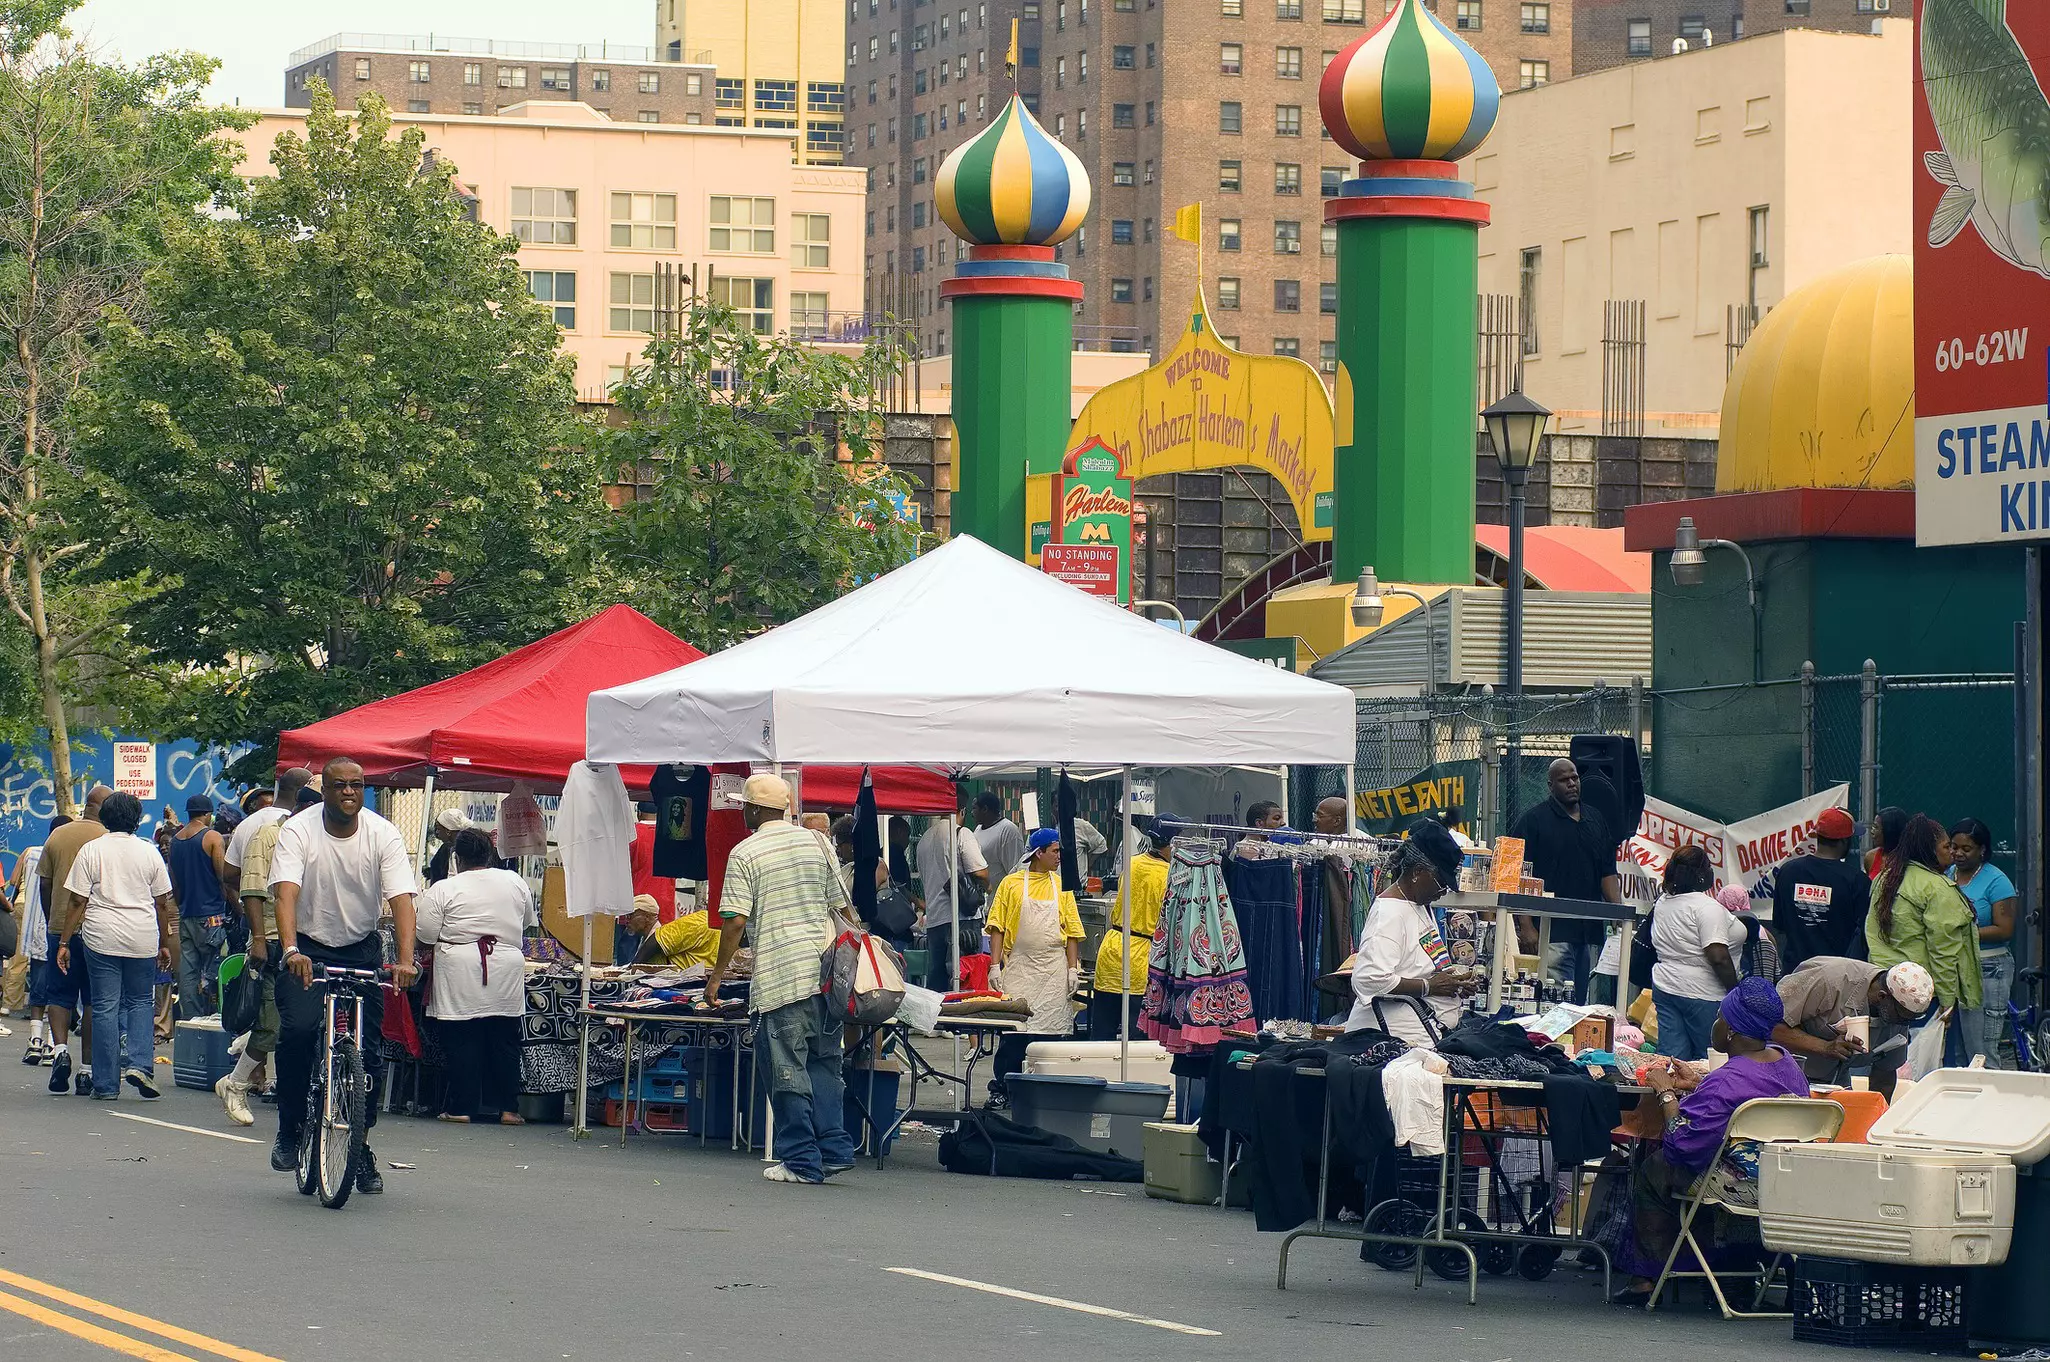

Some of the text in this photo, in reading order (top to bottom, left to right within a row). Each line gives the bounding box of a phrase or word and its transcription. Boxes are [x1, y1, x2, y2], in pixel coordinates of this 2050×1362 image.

[1935, 327, 2028, 372] 60-62W
[1164, 347, 1231, 389] WELCOME
[1190, 377, 1203, 392] TO
[1138, 401, 1193, 462] Shabazz
[1265, 412, 1317, 506] Market
[1065, 486, 1130, 524] Harlem
[1080, 522, 1112, 544] M
[1048, 549, 1113, 561] NO STANDING
[119, 745, 150, 753] SIDEWALK
[123, 755, 147, 763] CLOSED
[129, 769, 141, 777] USE
[116, 779, 154, 787] PEDESTRIAN
[121, 789, 150, 797] ALKWAY
[1798, 886, 1827, 898] DOHA
